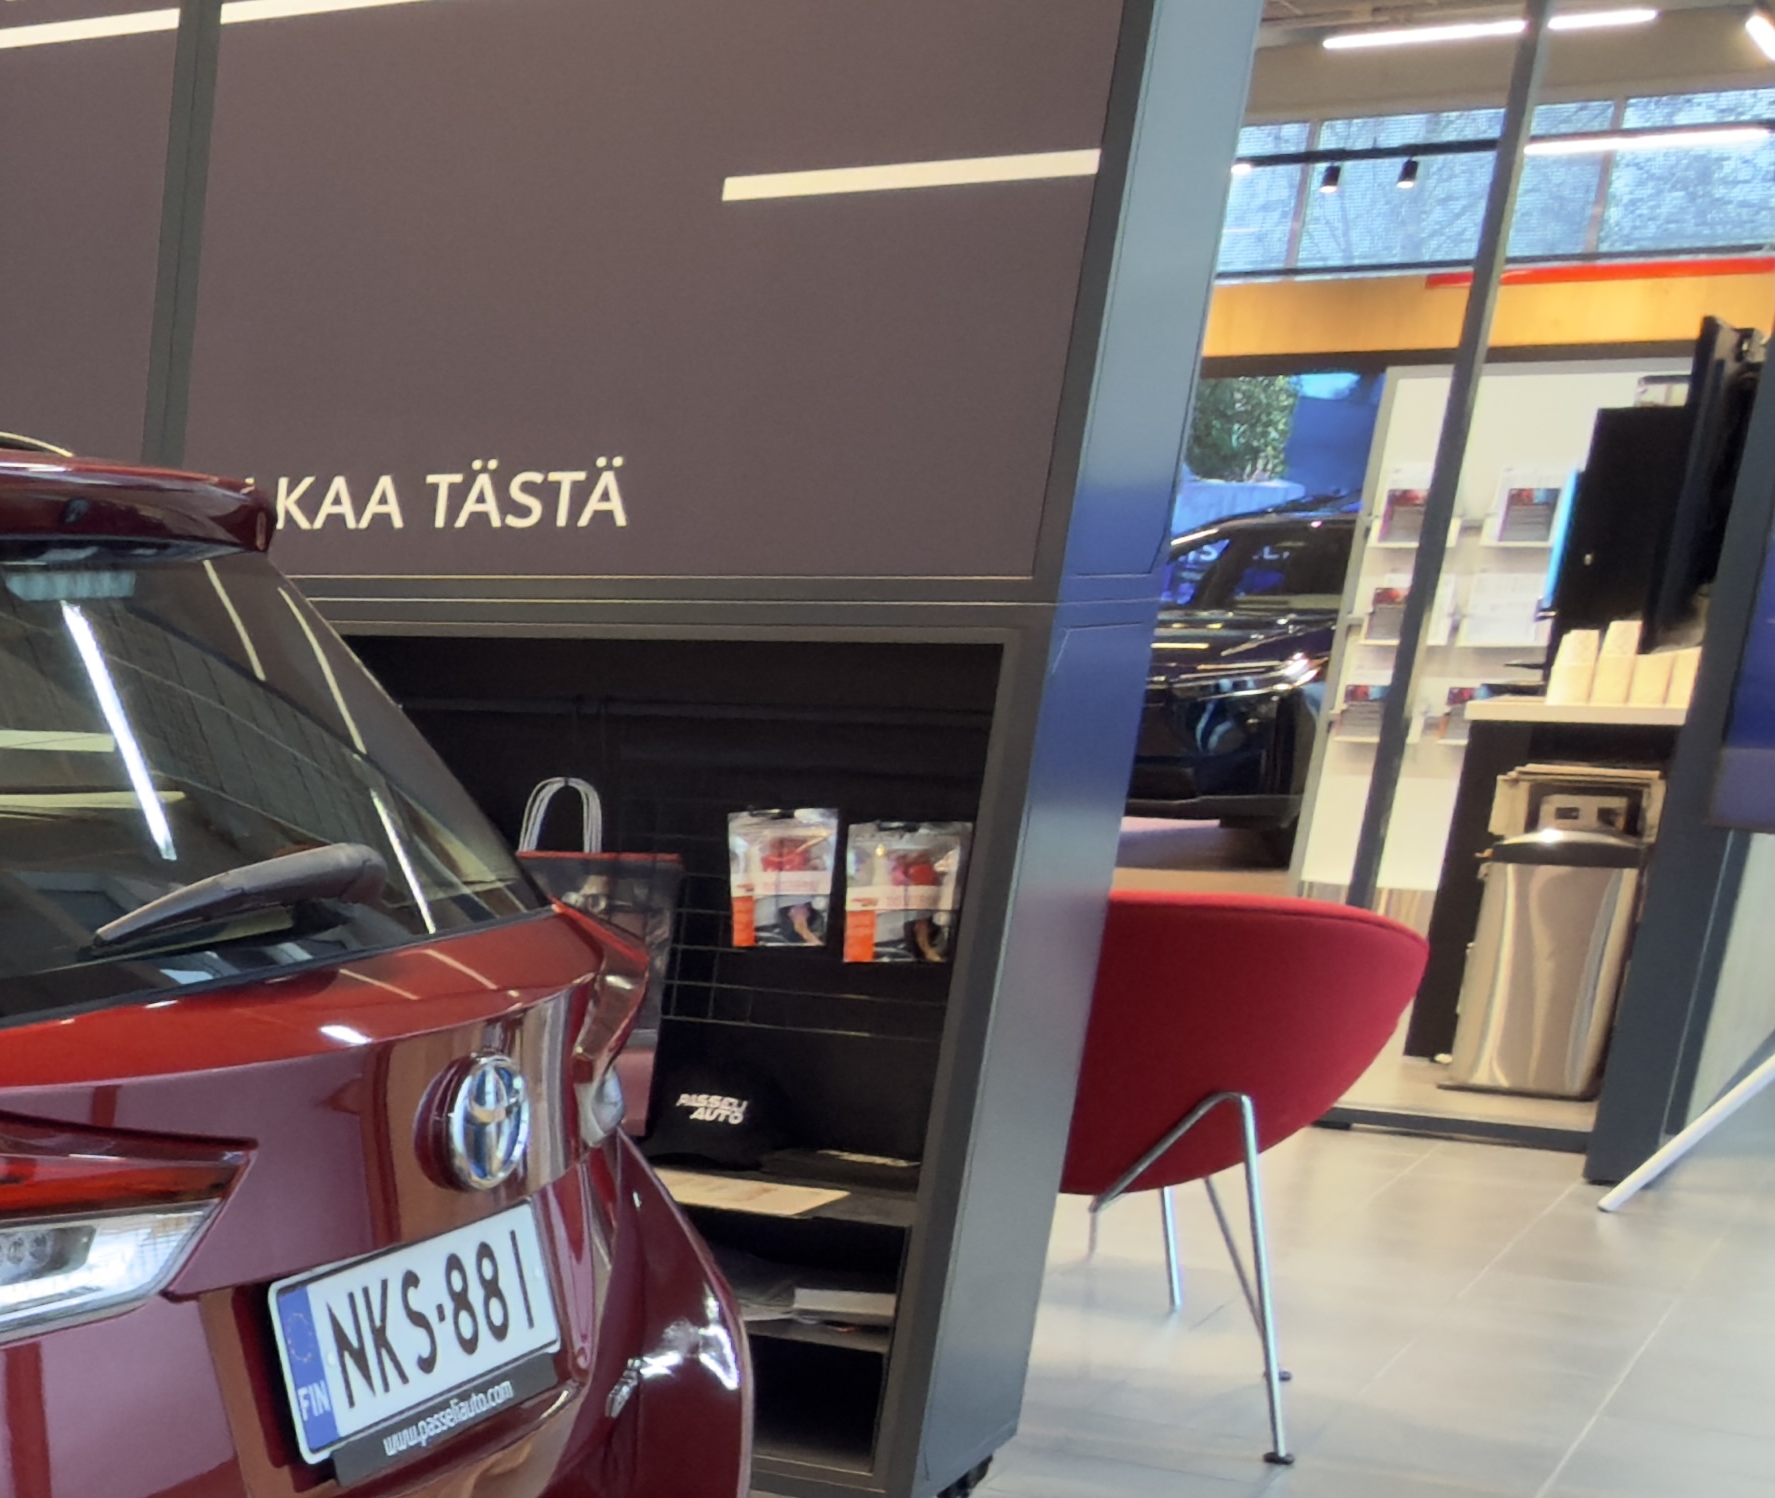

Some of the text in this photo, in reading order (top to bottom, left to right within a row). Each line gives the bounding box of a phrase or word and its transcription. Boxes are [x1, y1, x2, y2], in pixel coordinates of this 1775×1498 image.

[275, 455, 628, 531] KAA TÄSTÄ
[689, 1107, 744, 1125] AUTO
[326, 1229, 535, 1409] NKS-881
[297, 1380, 331, 1421] FIN
[382, 1380, 514, 1457] www.passeliauto.com
